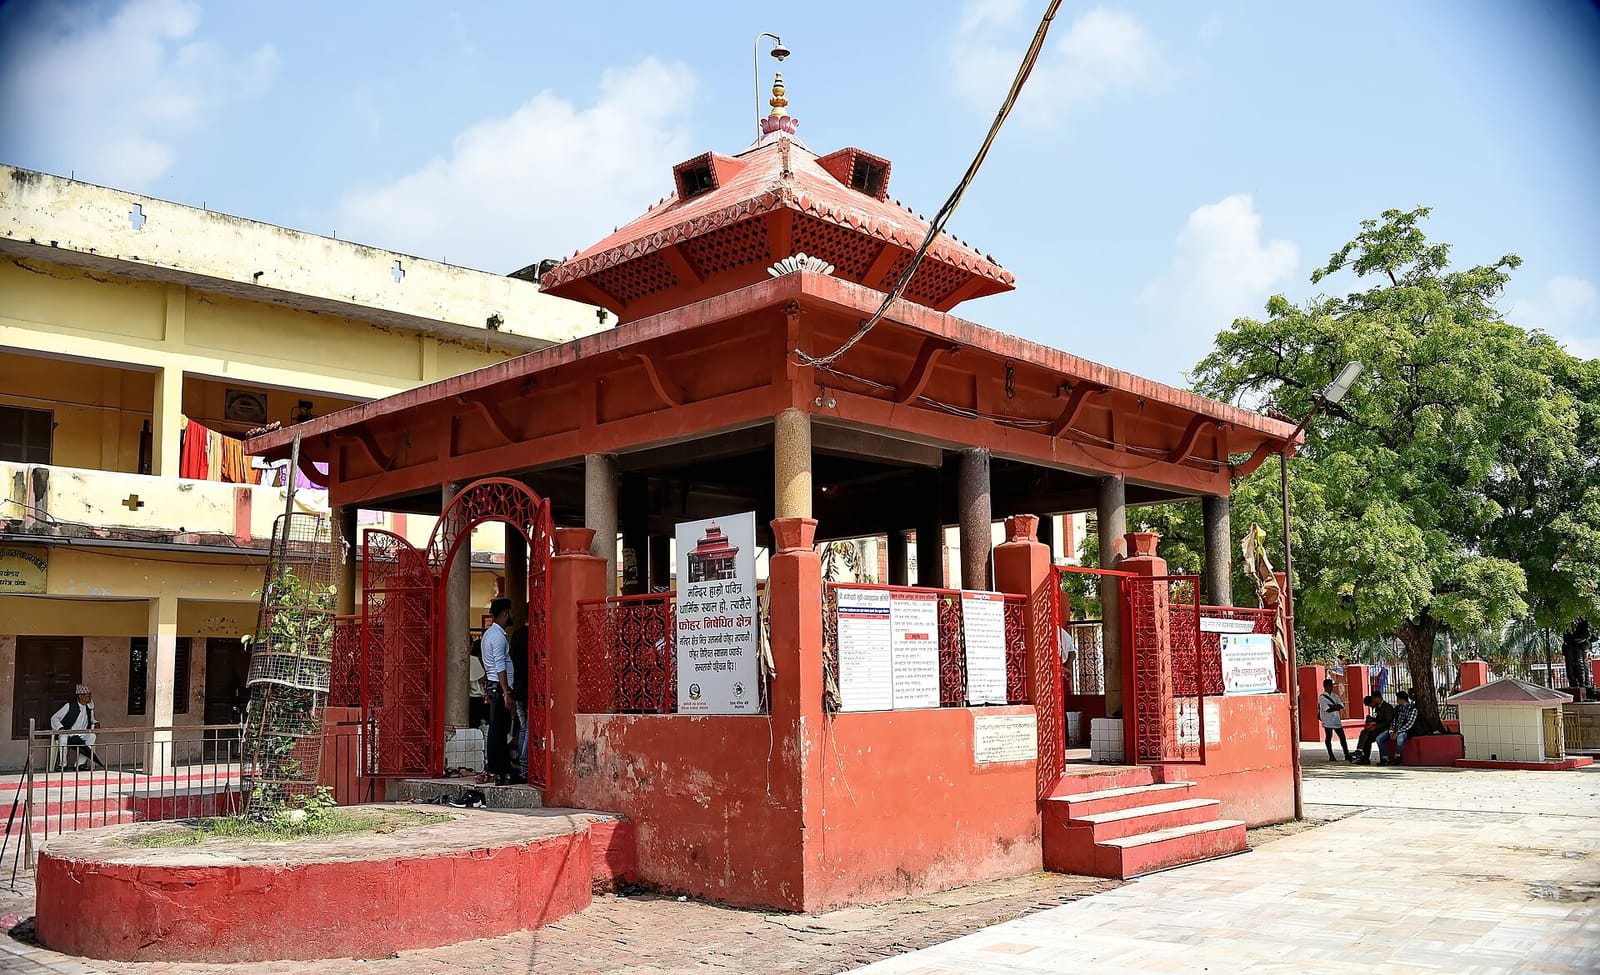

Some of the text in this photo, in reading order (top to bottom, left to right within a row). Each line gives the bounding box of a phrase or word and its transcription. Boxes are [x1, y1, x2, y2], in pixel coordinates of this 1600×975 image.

[688, 581, 742, 598] मन्दिर हाम्रो पवित्र
[680, 596, 752, 613] धार्मिक स्थल हो, त्यसैले
[679, 614, 752, 631] फोहर निषेधित क्षेत्र
